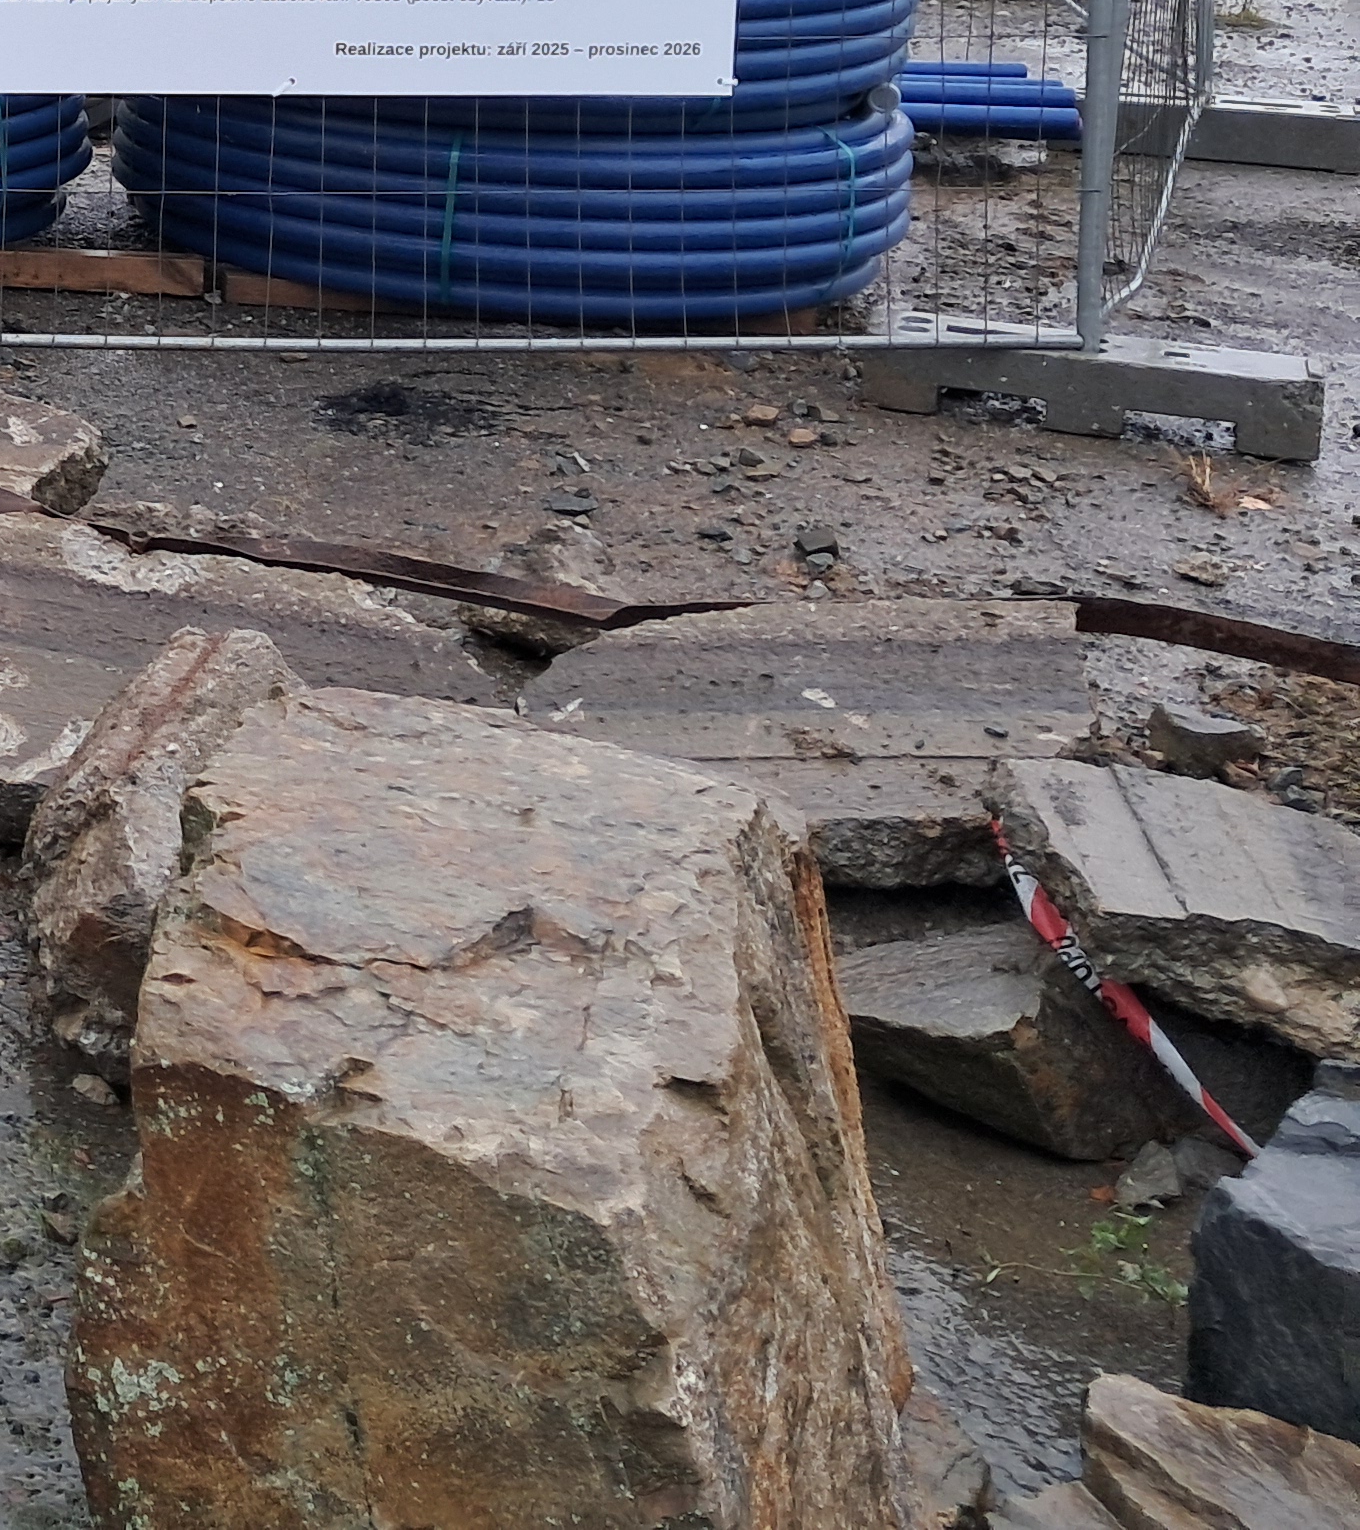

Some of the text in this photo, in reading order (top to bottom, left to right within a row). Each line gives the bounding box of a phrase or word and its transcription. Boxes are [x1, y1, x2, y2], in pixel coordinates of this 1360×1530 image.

[336, 42, 414, 55] Realizace
[419, 42, 491, 59] projektu:
[497, 42, 526, 55] září
[532, 43, 569, 55] 2025
[589, 43, 658, 59] prosinec
[664, 43, 700, 55] 2026
